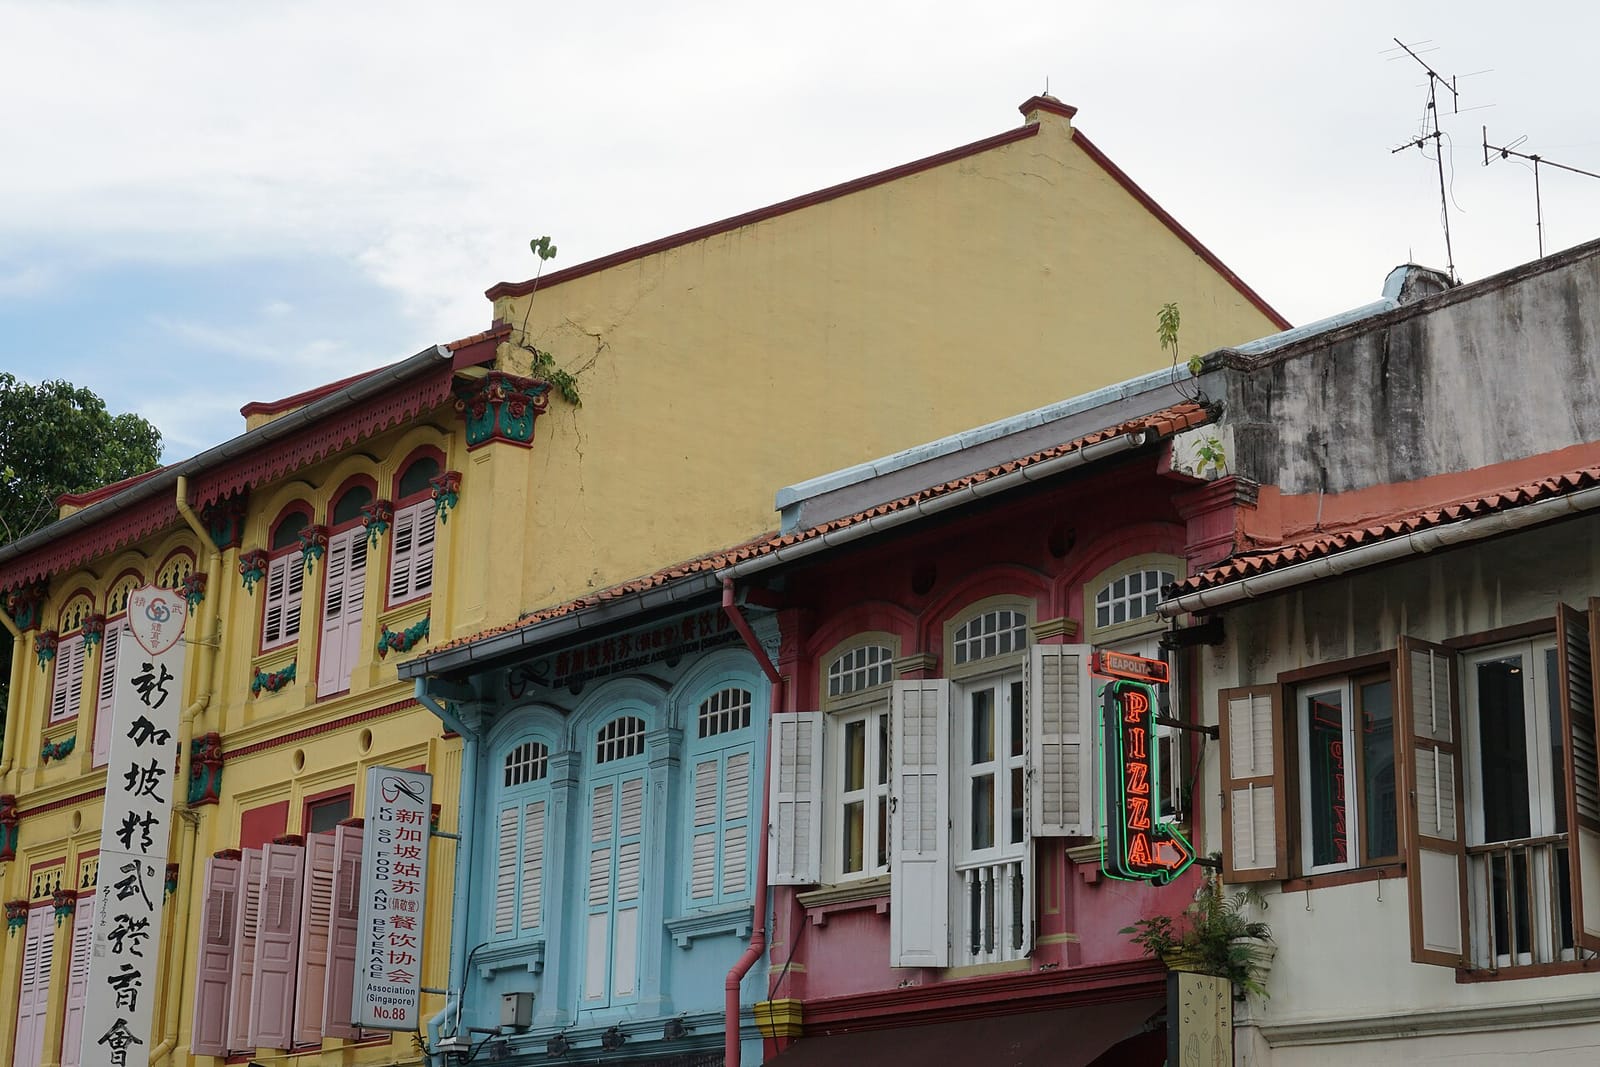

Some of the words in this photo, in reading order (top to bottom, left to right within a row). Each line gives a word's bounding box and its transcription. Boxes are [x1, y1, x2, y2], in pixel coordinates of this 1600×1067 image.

[1124, 691, 1152, 866] PIZZA
[380, 807, 393, 821] KU
[376, 851, 390, 880] FOOD
[374, 888, 388, 910] AND
[370, 919, 385, 978] BEVERAGE
[367, 983, 416, 996] Association
[366, 993, 415, 1007] (Singapore)
[374, 1005, 406, 1021] No.88
